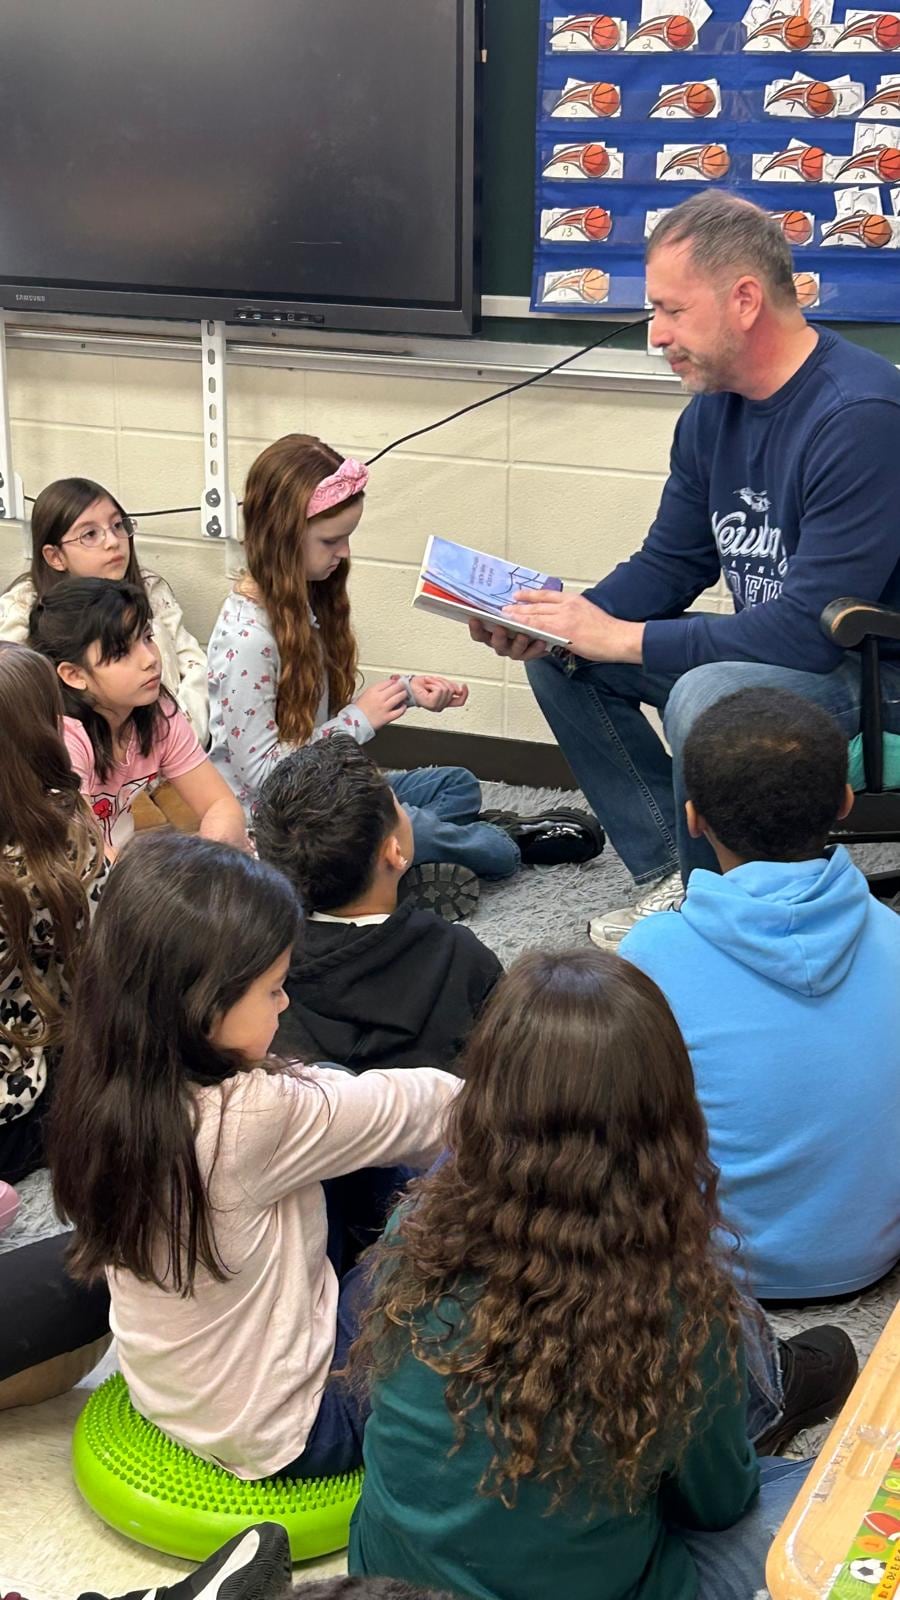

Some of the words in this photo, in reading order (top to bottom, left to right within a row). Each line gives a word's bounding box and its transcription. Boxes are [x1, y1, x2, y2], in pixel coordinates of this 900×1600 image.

[569, 33, 577, 44] 1
[642, 38, 654, 50] 2
[762, 37, 771, 49] 3
[853, 38, 862, 49] 4
[571, 104, 578, 116] 5
[666, 106, 675, 117] 6
[785, 101, 796, 113] 7
[880, 106, 888, 116] 8
[562, 165, 569, 175] 9
[779, 169, 787, 180] 11
[854, 171, 866, 180] 12
[561, 227, 573, 237] 13
[15, 294, 46, 302] SAMSUNG
